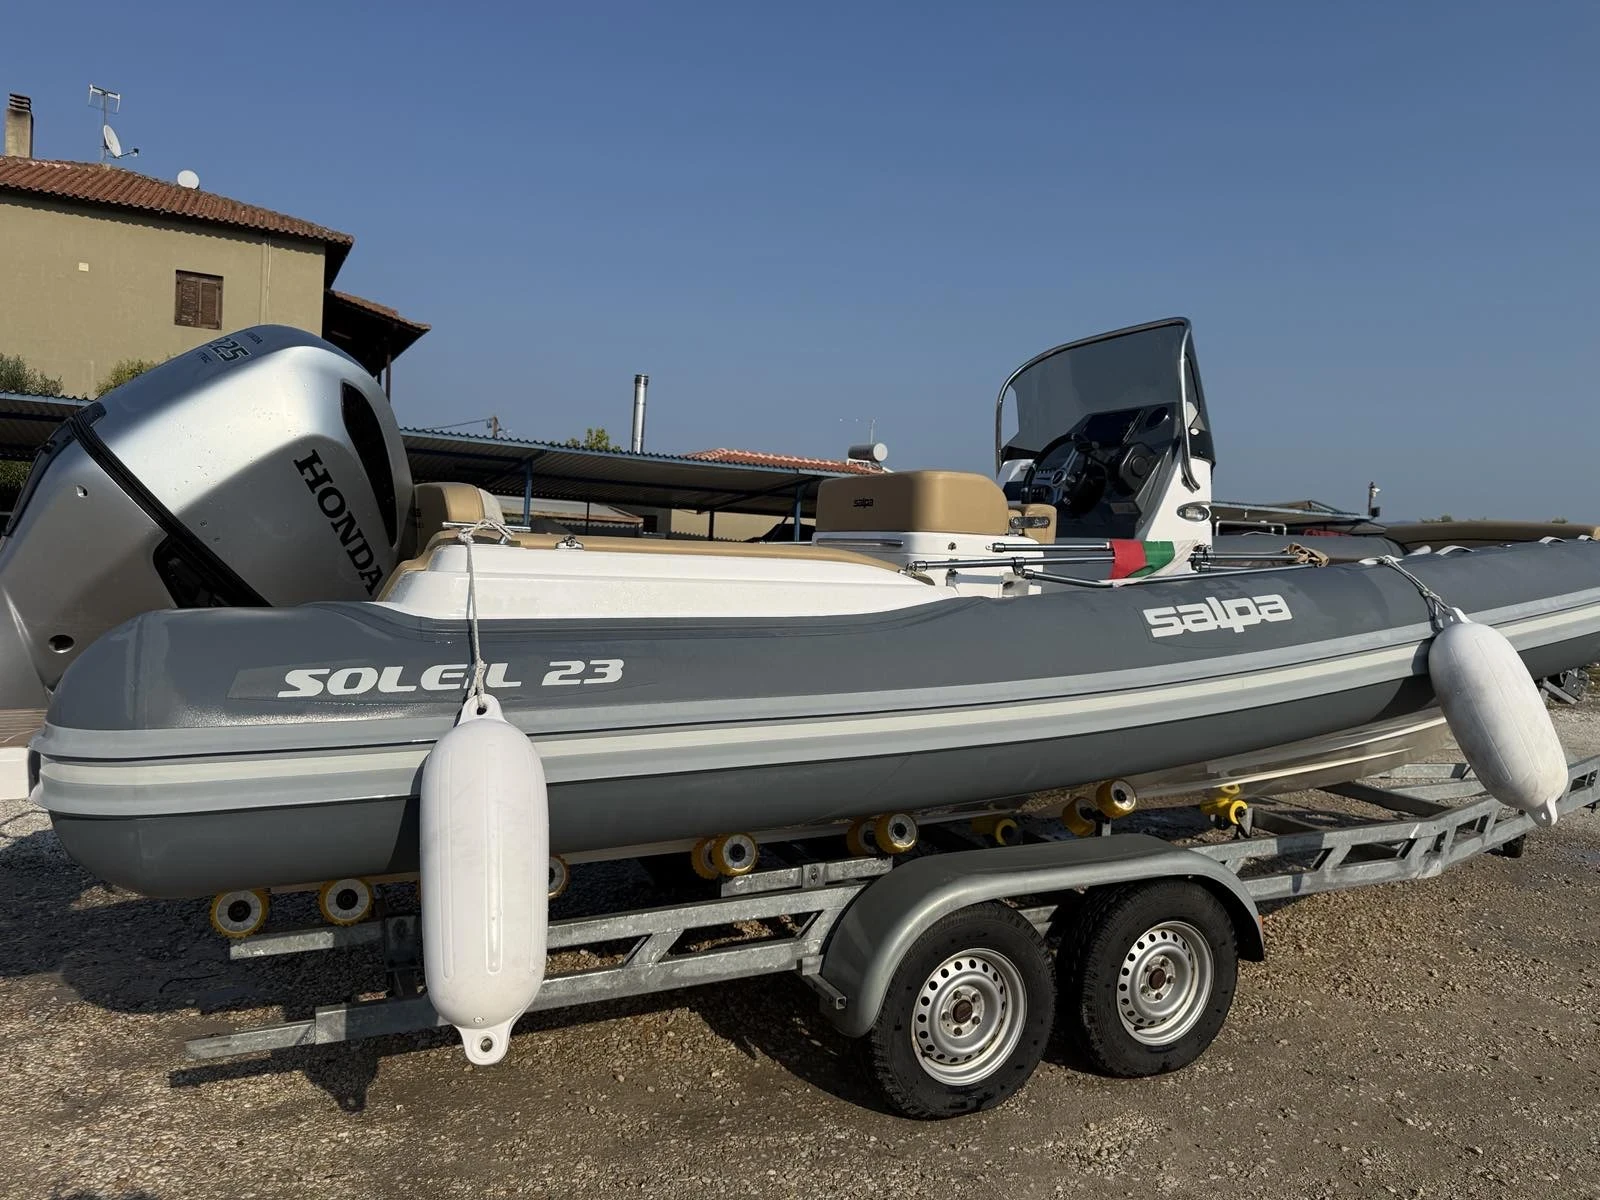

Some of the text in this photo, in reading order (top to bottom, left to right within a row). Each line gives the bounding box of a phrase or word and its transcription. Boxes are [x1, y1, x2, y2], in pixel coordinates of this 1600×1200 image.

[293, 449, 384, 596] HONDA
[1143, 594, 1293, 638] salpa
[277, 658, 625, 698] SOLEL 23
